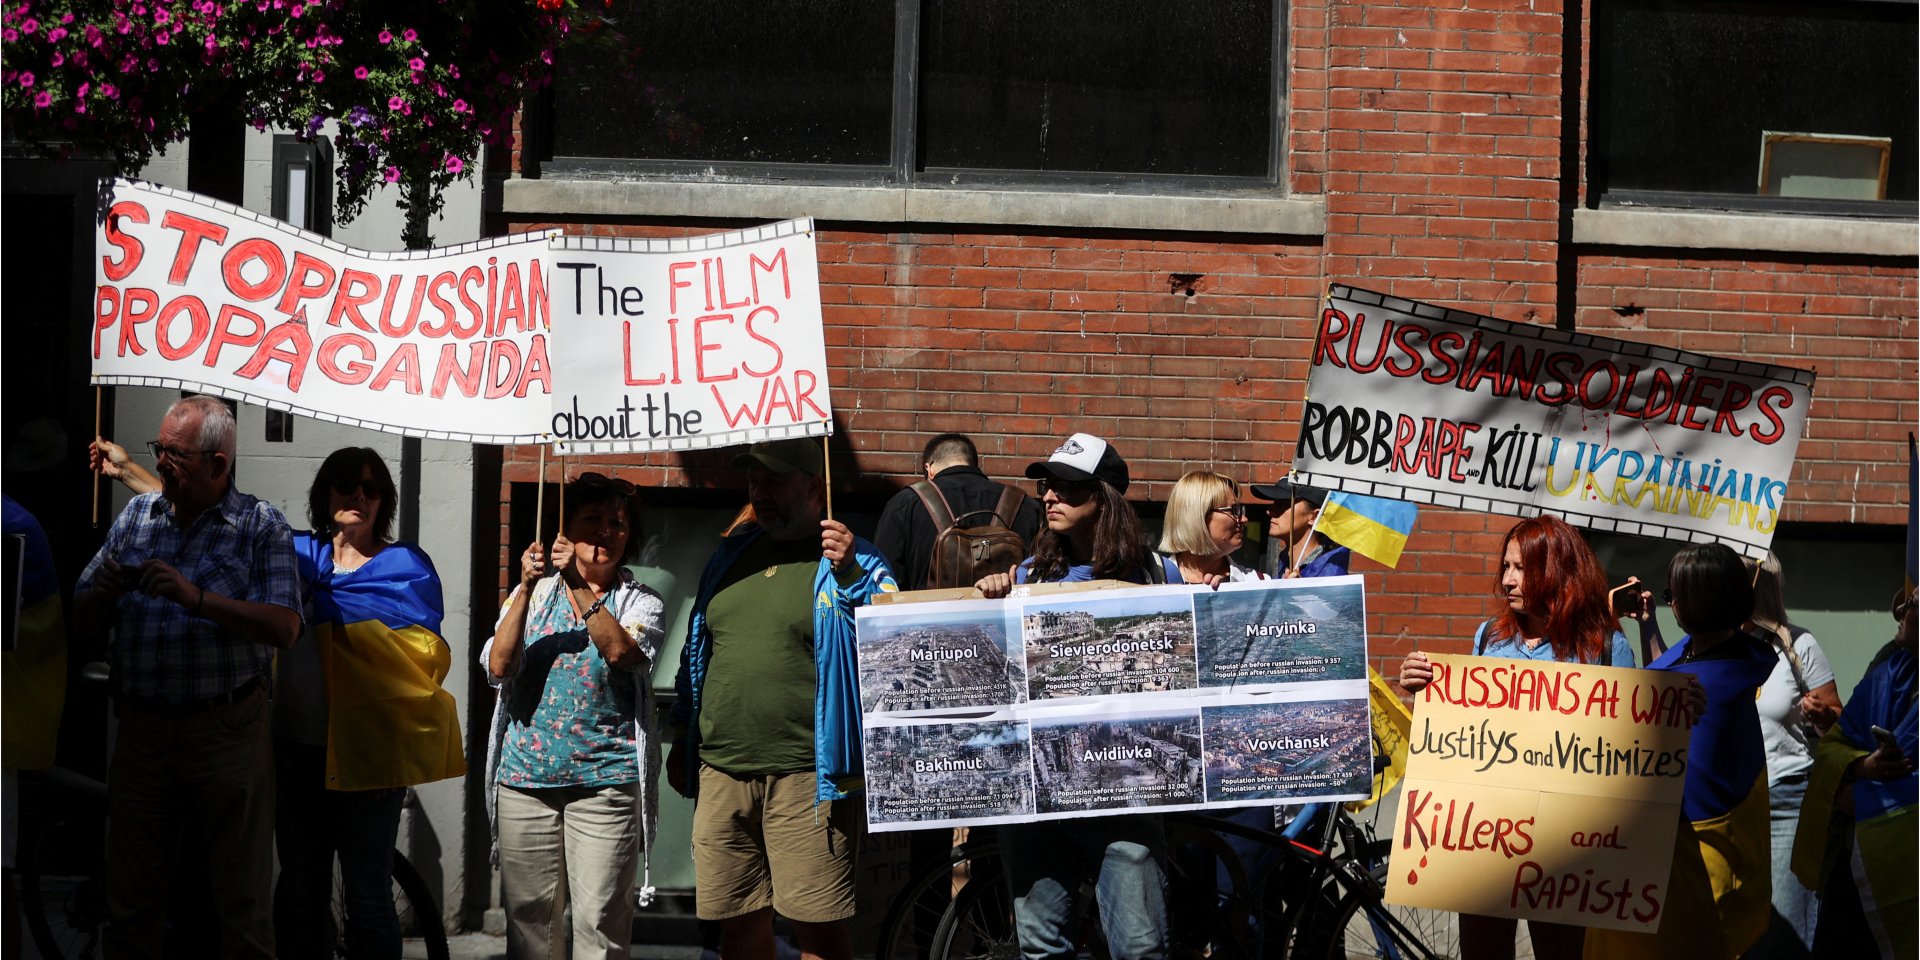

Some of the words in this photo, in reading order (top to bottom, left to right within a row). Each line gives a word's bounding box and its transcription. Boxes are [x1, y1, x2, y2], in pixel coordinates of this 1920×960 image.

[103, 201, 336, 315] STOP
[557, 262, 644, 316] The
[669, 247, 791, 315] FILM
[94, 285, 552, 399] PROPAGANDA
[623, 305, 783, 386] LIES
[1313, 308, 1545, 401] RUSSIAN
[1534, 353, 1794, 445] SOLDIERS
[552, 394, 641, 440] about
[641, 391, 703, 439] the
[711, 370, 828, 429] WAR
[1390, 413, 1482, 484] RAPE
[1465, 468, 1480, 477] AND
[1478, 423, 1543, 492] KILL
[1545, 436, 1787, 535] UKRAINIANS
[1050, 635, 1174, 659] Sievierodonetsk
[1246, 620, 1317, 639] Maryinka
[910, 645, 979, 664] Mariupol
[1425, 662, 1582, 715] RUSSIANS
[1585, 679, 1620, 719] At
[1083, 745, 1152, 762] Avidiivka
[1248, 733, 1330, 752] Vovchansk
[1523, 743, 1553, 767] and
[915, 757, 984, 773] Bakhmut
[1571, 825, 1628, 850] and
